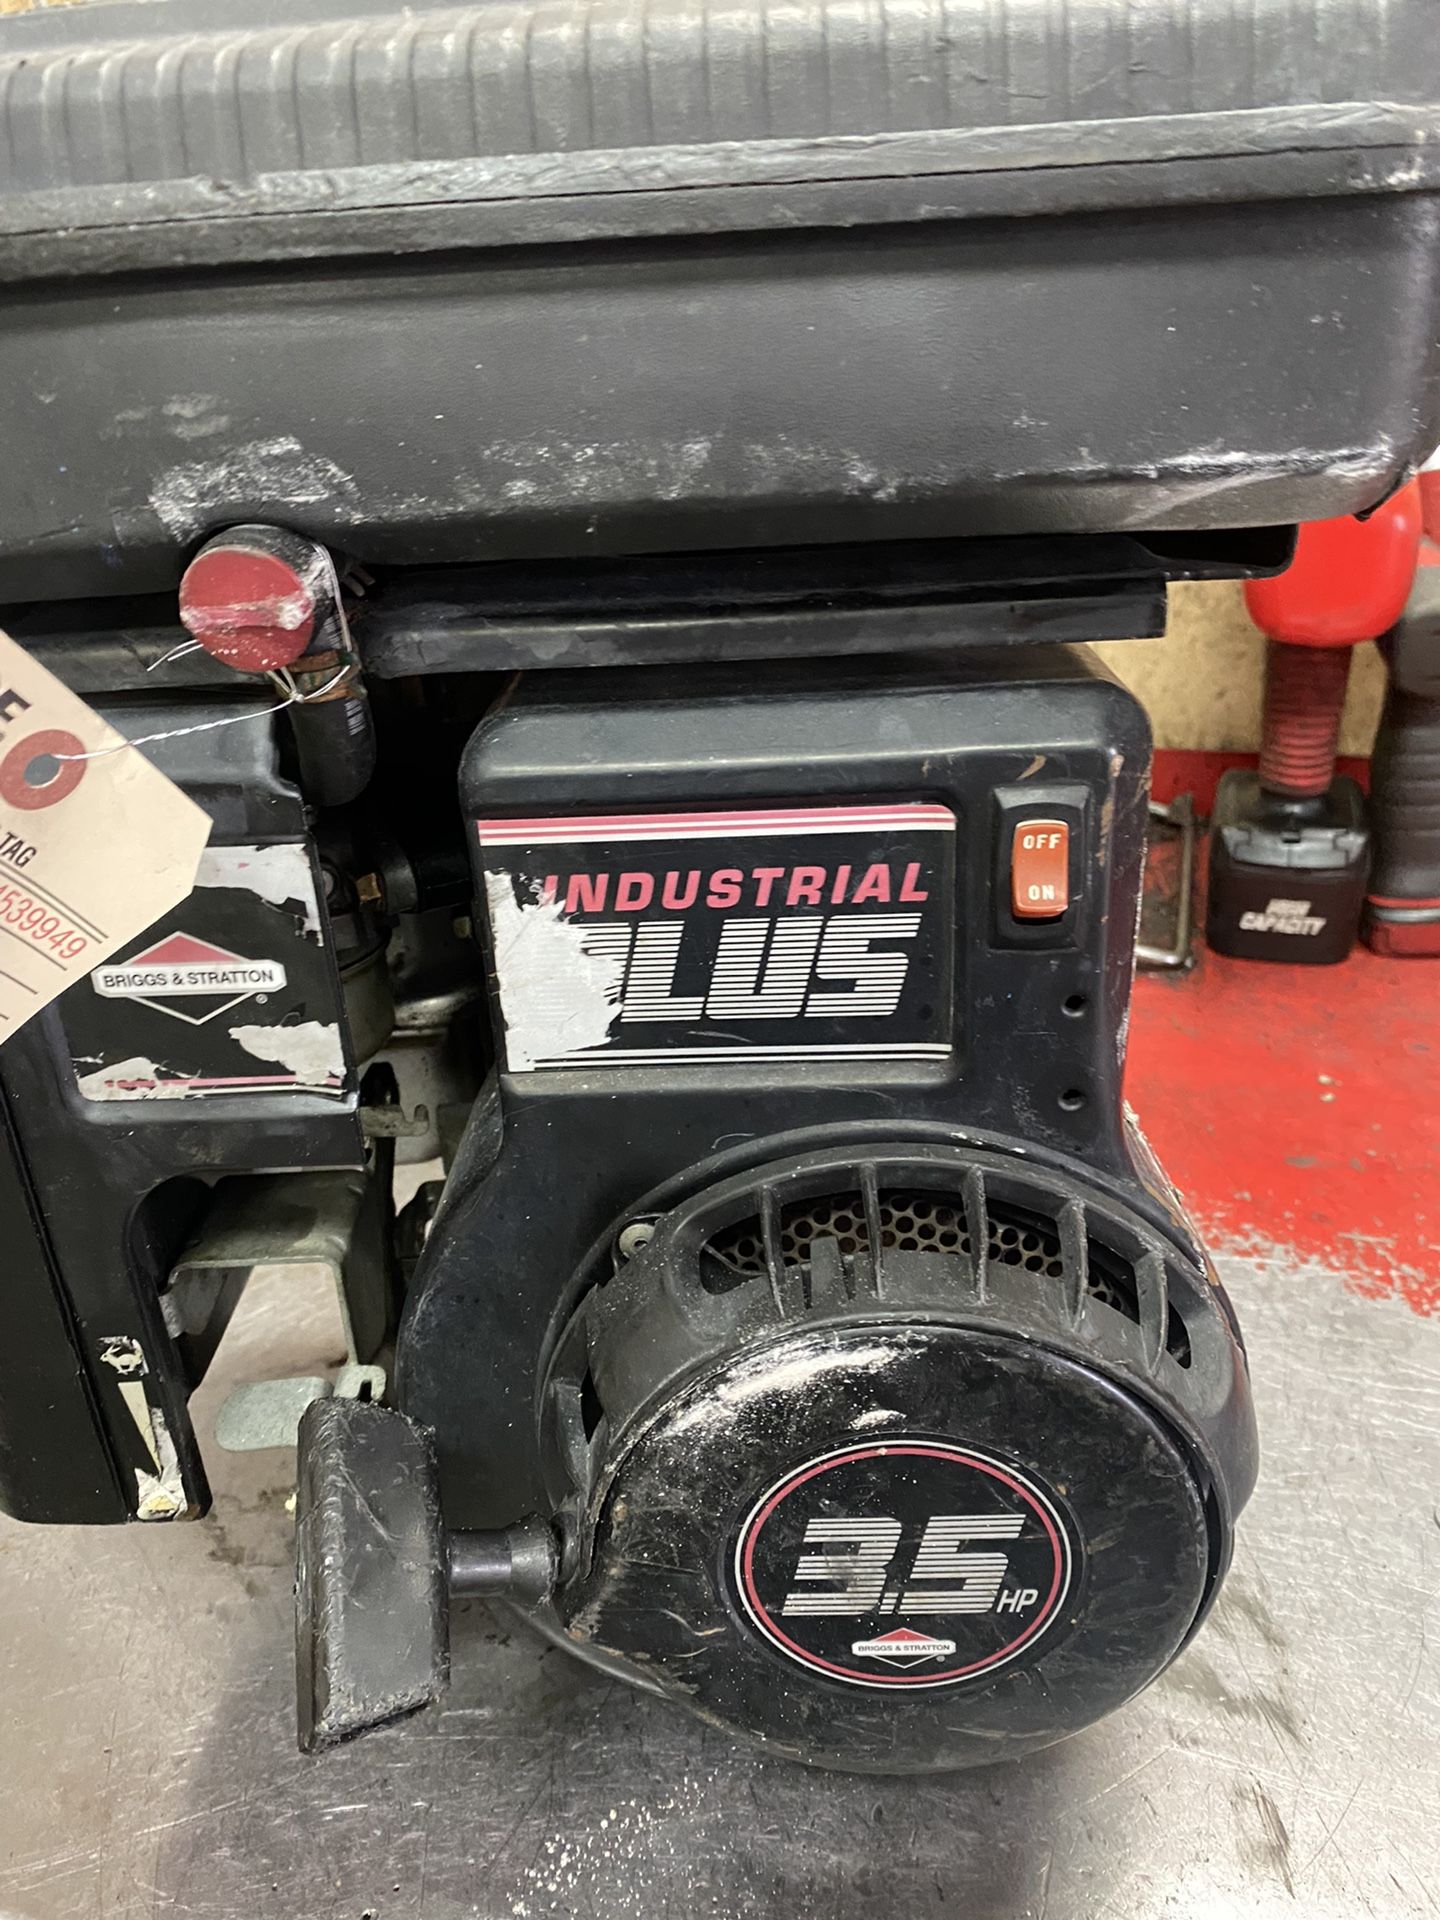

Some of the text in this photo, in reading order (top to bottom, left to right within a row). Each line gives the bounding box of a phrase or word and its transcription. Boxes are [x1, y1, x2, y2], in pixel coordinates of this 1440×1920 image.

[0, 831, 37, 868] TAG
[1022, 833, 1062, 850] OFF
[540, 863, 928, 913] INDUSTRIAL
[1027, 884, 1055, 901] ON
[103, 969, 274, 988] BRIGGS & STRATTON
[781, 1513, 1039, 1617] 3.5 HP
[903, 1644, 951, 1652] STRATTON
